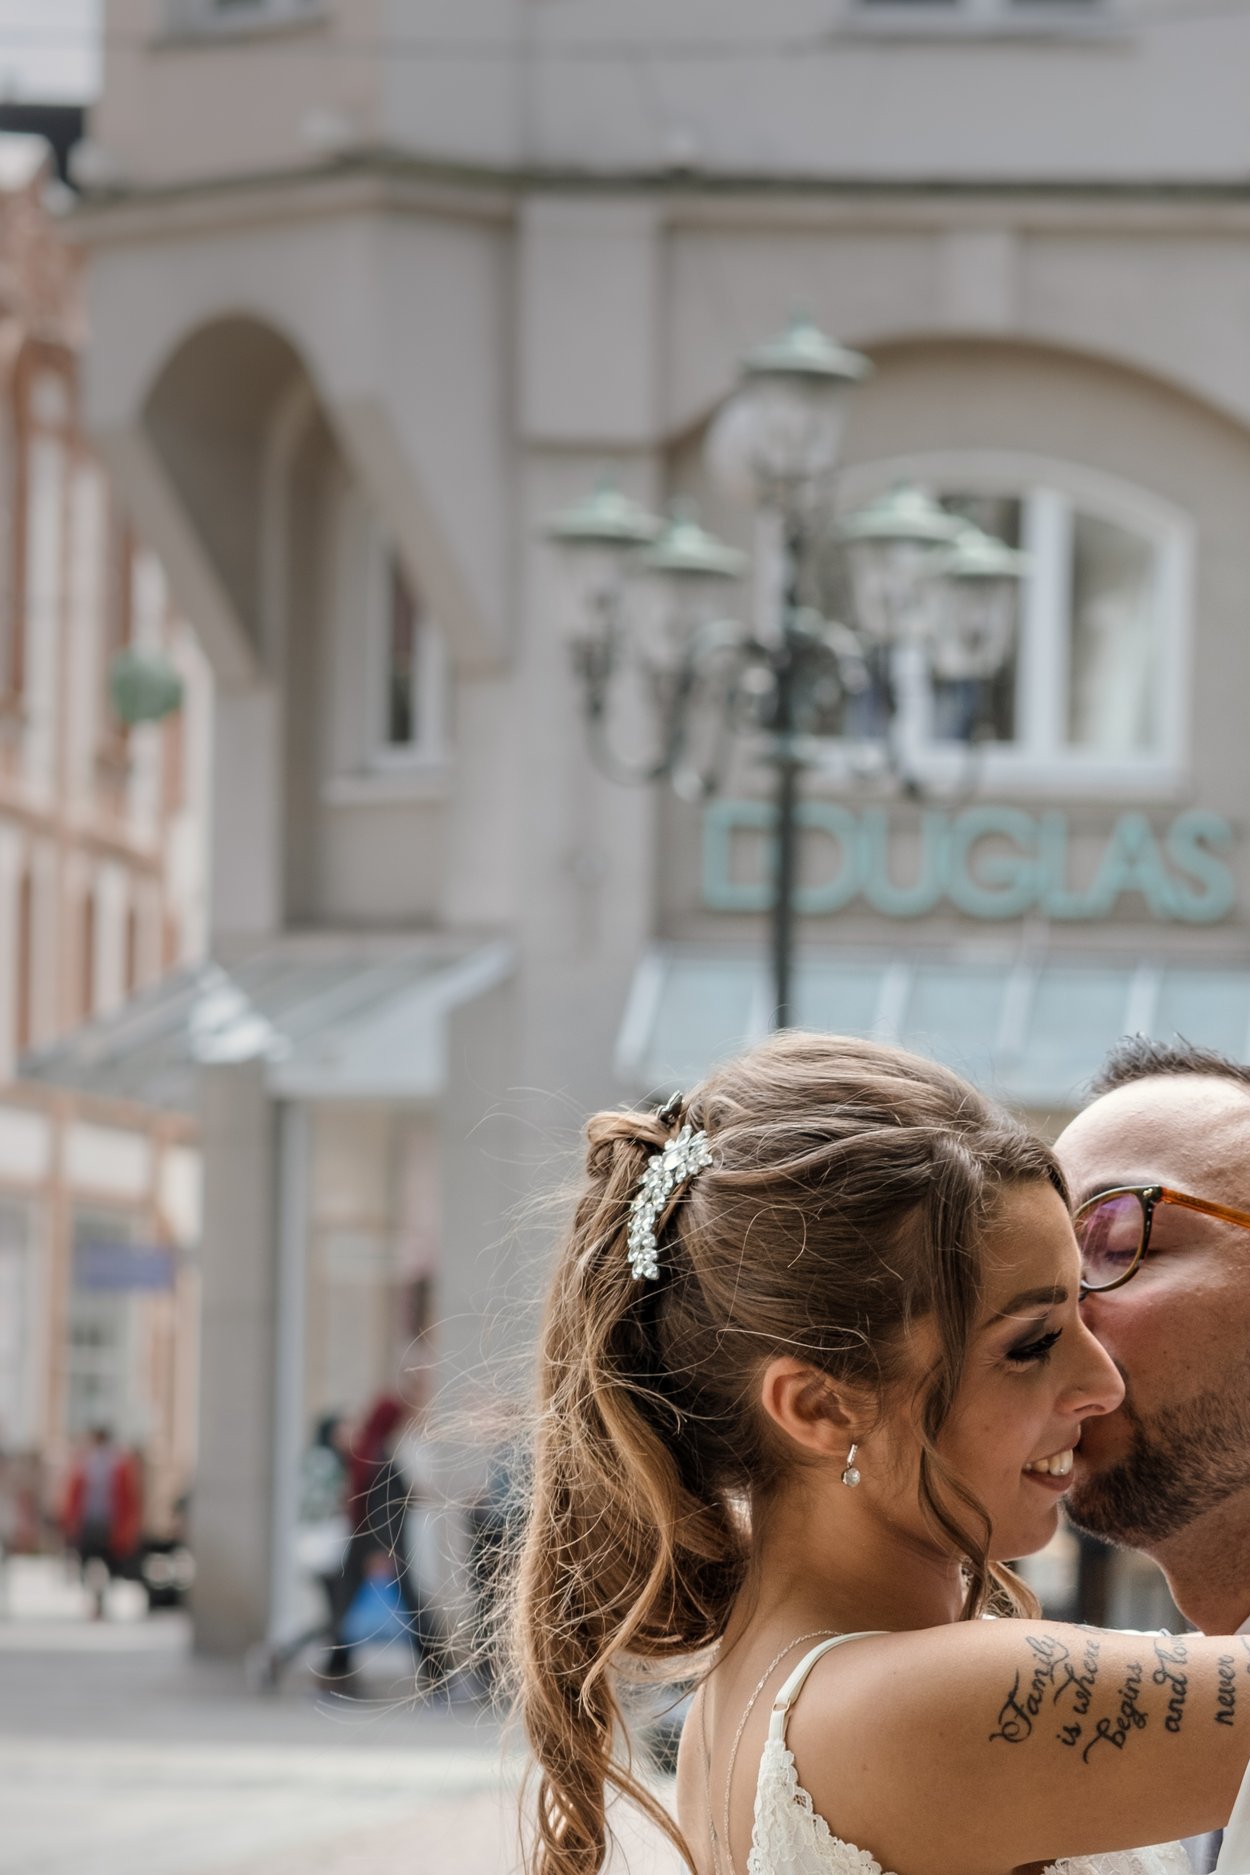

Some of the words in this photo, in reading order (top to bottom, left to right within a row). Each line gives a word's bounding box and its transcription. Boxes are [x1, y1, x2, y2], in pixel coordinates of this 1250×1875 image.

[702, 802, 1236, 922] DOUGLAS
[989, 1634, 1069, 1743] Family
[1053, 1639, 1100, 1715] where
[1082, 1660, 1147, 1764] begins
[1152, 1664, 1188, 1733] and
[1214, 1654, 1236, 1727] never
[1056, 1723, 1082, 1746] is
